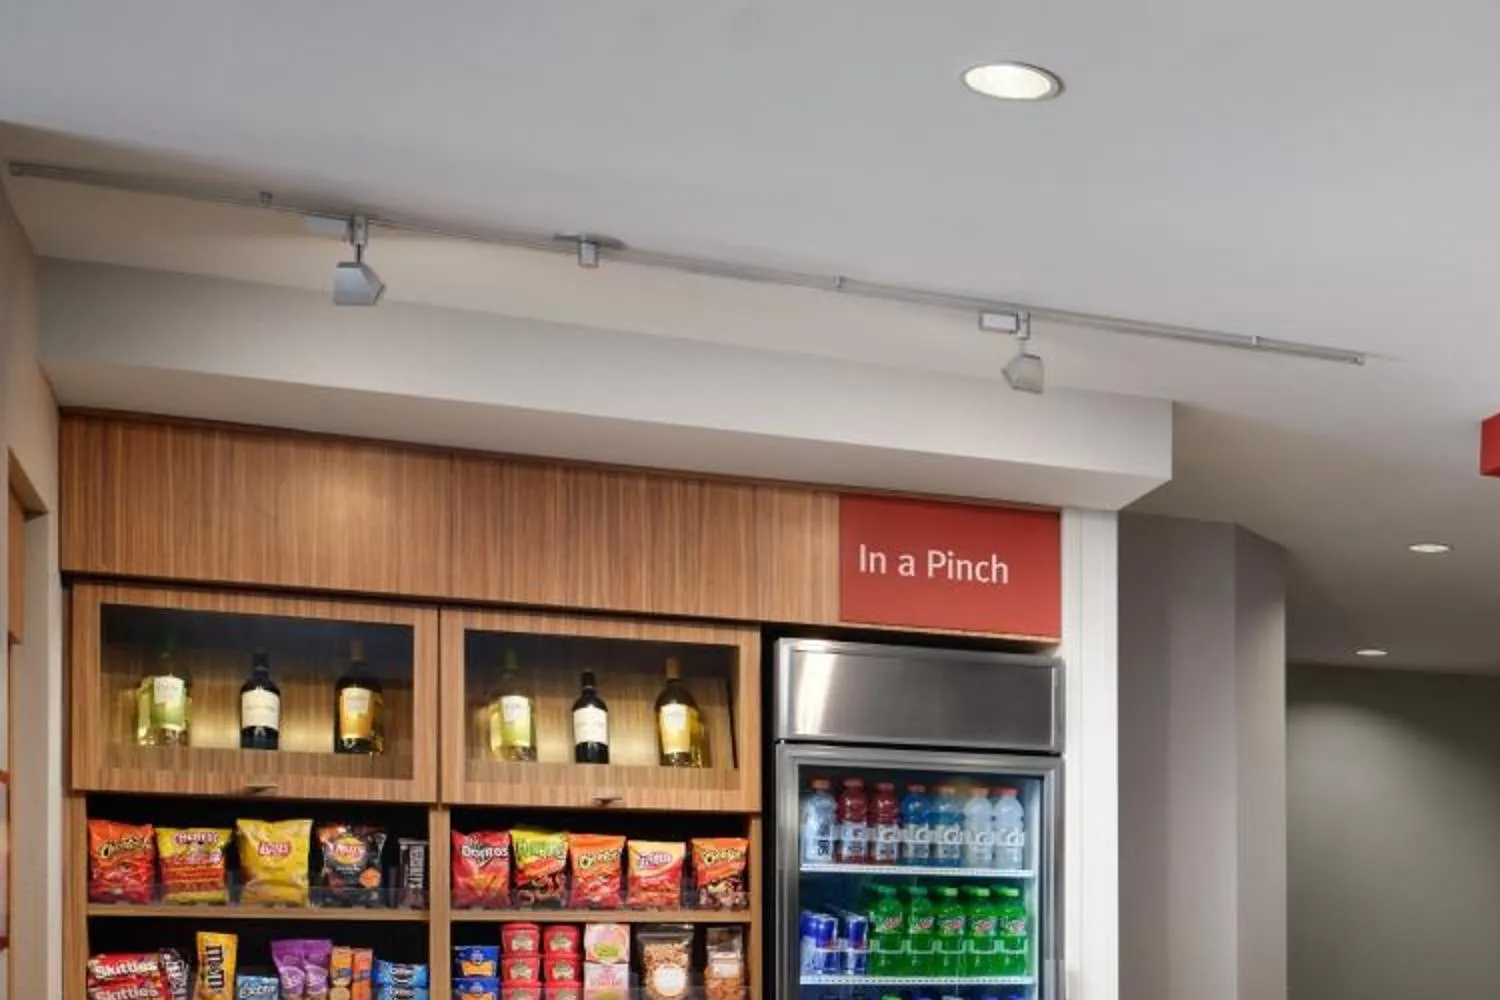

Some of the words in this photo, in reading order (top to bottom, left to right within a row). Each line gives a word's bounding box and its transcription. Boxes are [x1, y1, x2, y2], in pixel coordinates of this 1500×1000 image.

[859, 543, 886, 575] In
[898, 554, 915, 577] a
[927, 549, 1009, 585] Pinch
[94, 958, 159, 979] Skittles
